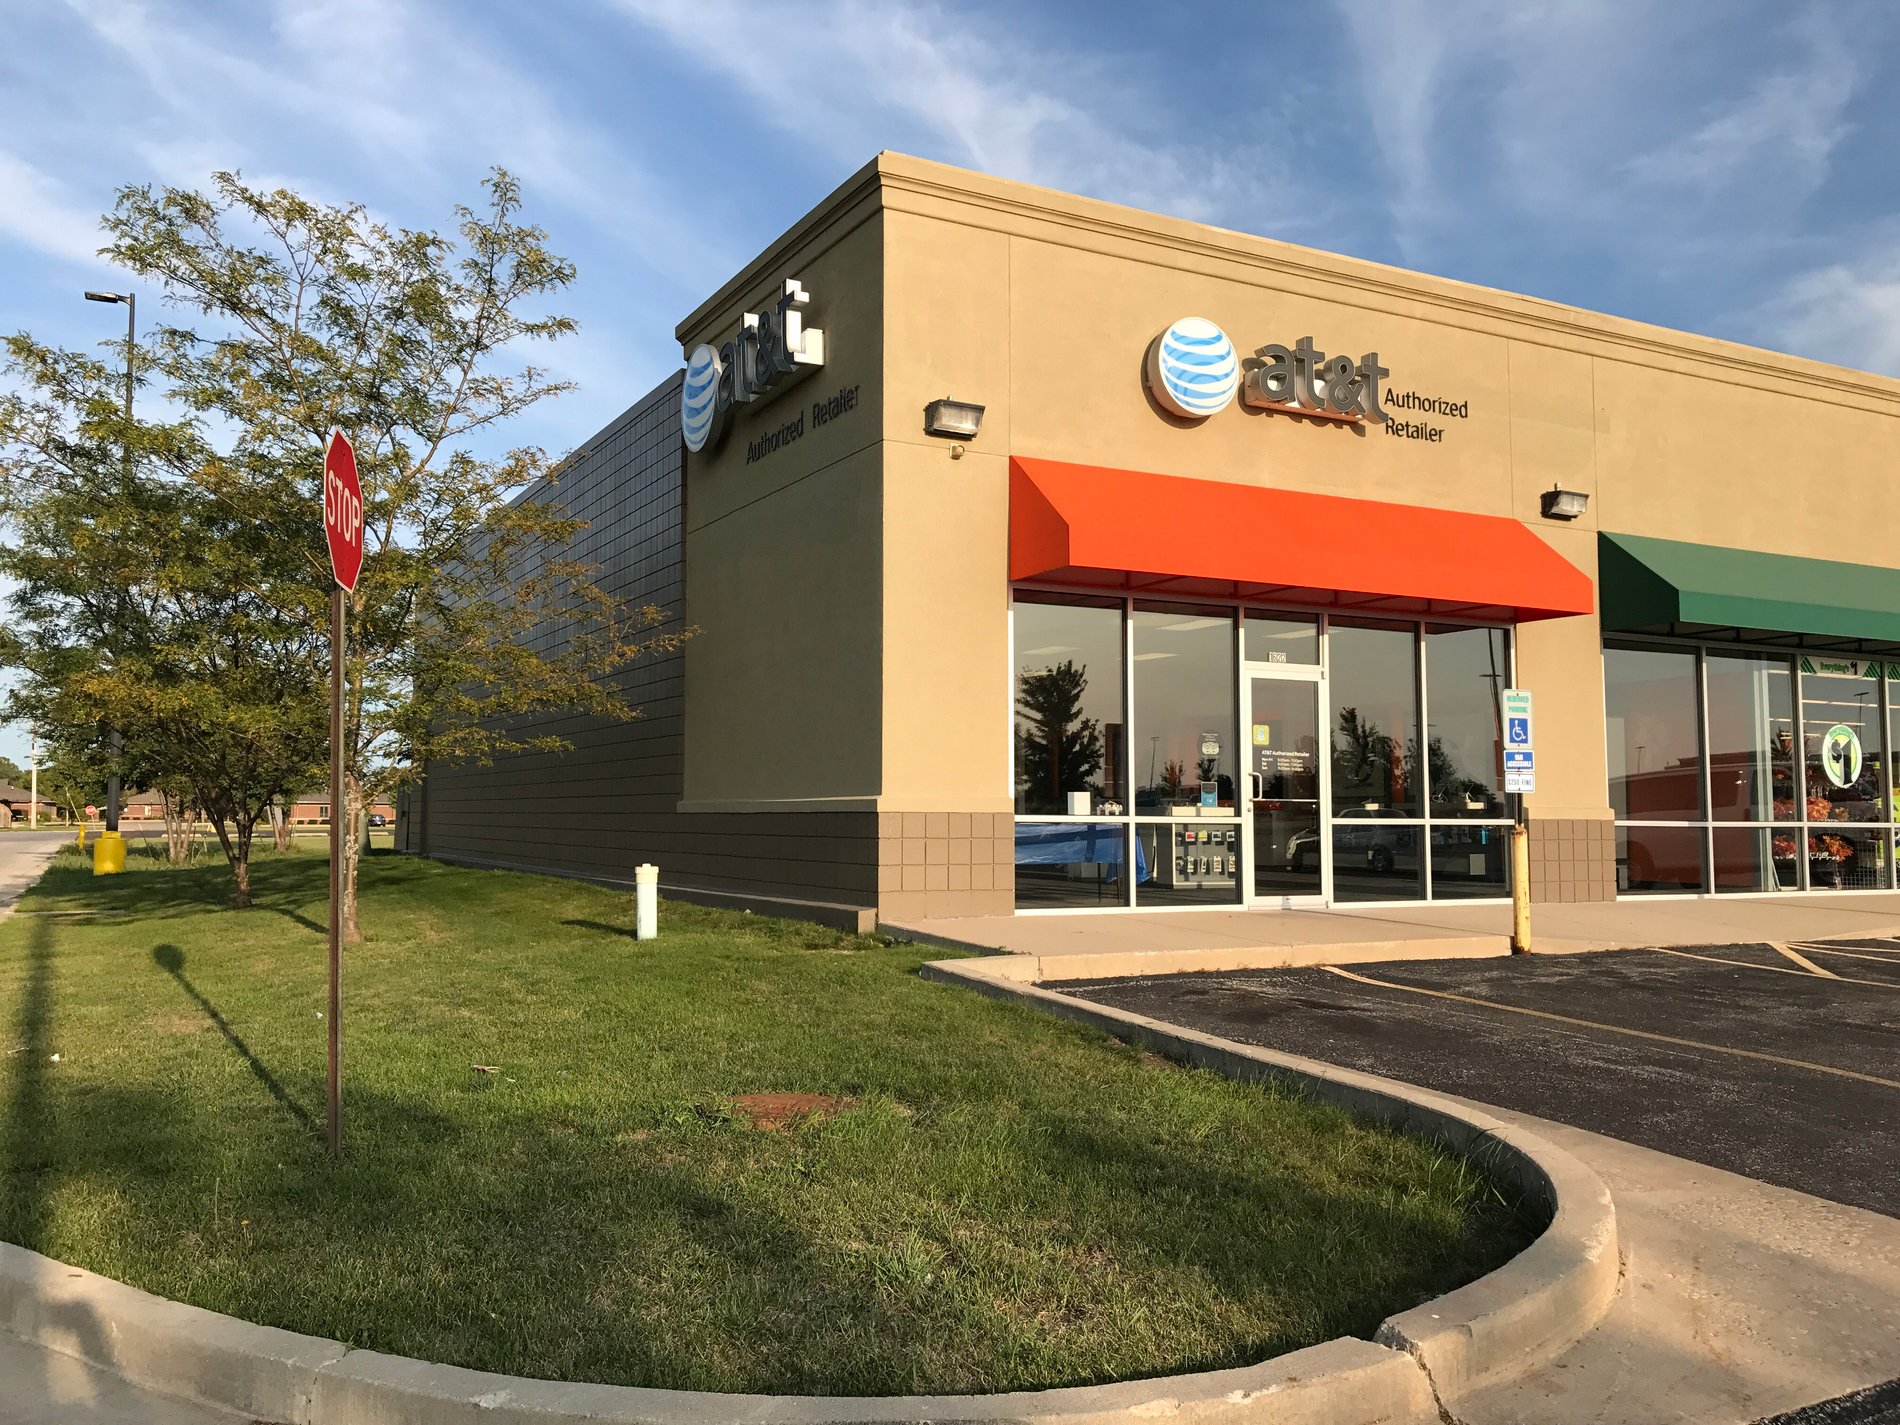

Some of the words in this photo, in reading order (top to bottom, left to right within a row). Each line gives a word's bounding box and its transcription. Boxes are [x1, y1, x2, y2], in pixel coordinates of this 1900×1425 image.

[717, 278, 825, 412] at&t
[1248, 336, 1390, 424] at&t
[746, 410, 804, 464] Authorized
[812, 384, 860, 429] Retailer
[1384, 387, 1469, 419] Authorized
[1385, 417, 1445, 443] Retailer
[327, 469, 361, 547] STOP
[1508, 705, 1528, 713] PARKING
